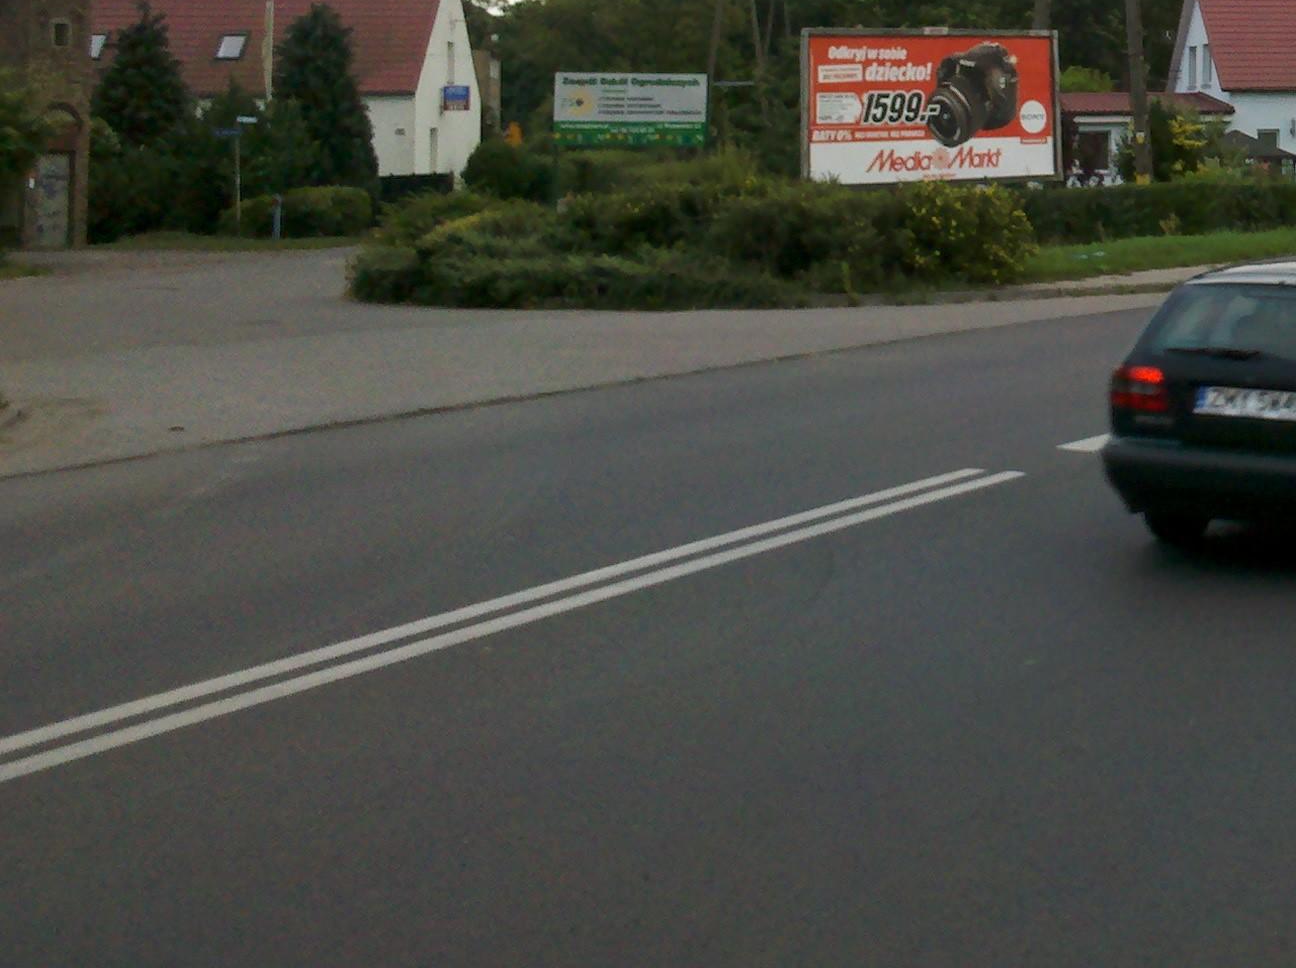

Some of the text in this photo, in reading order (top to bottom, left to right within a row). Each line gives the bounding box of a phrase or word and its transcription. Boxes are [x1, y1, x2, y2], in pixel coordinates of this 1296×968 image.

[865, 62, 932, 81] dziecko!
[865, 146, 1002, 172] Media Markt
